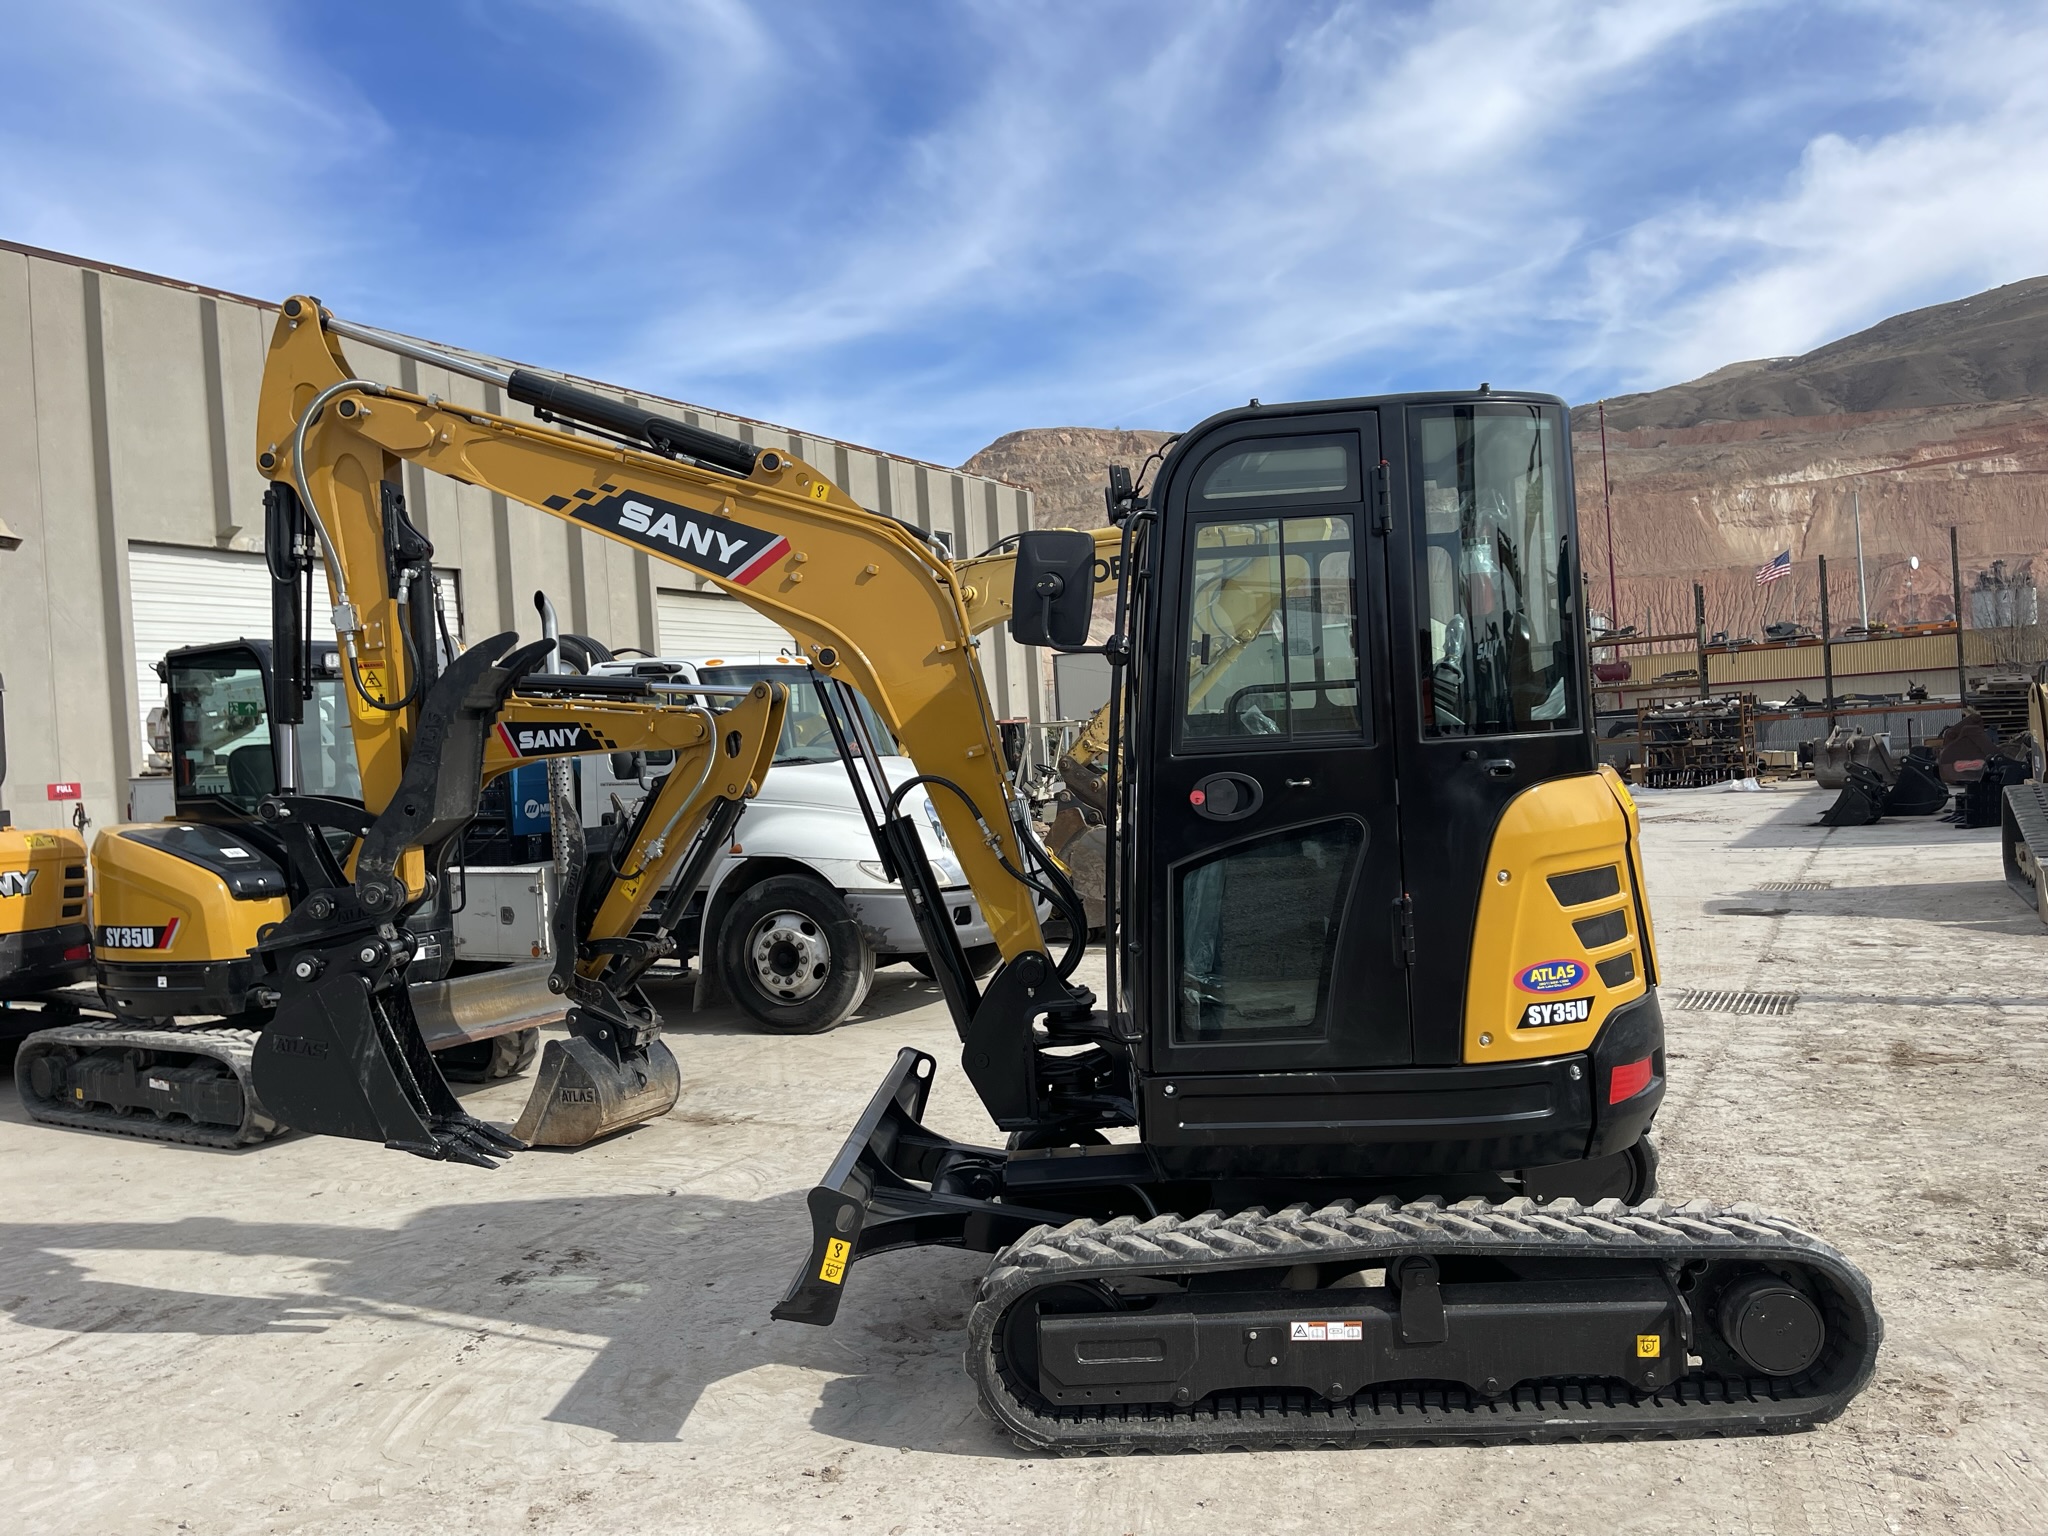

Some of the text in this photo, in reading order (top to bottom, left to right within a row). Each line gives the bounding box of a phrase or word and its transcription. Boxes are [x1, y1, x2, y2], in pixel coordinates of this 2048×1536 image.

[618, 500, 748, 564] SANY
[519, 728, 580, 749] SANY
[56, 785, 73, 793] FULL
[566, 865, 580, 894] ATLAS
[106, 927, 154, 948] SY35U
[1530, 964, 1576, 983] ATLAS
[1528, 1000, 1588, 1025] SY35U
[276, 1038, 323, 1056] ATLAS
[562, 1090, 593, 1102] ATLAS
